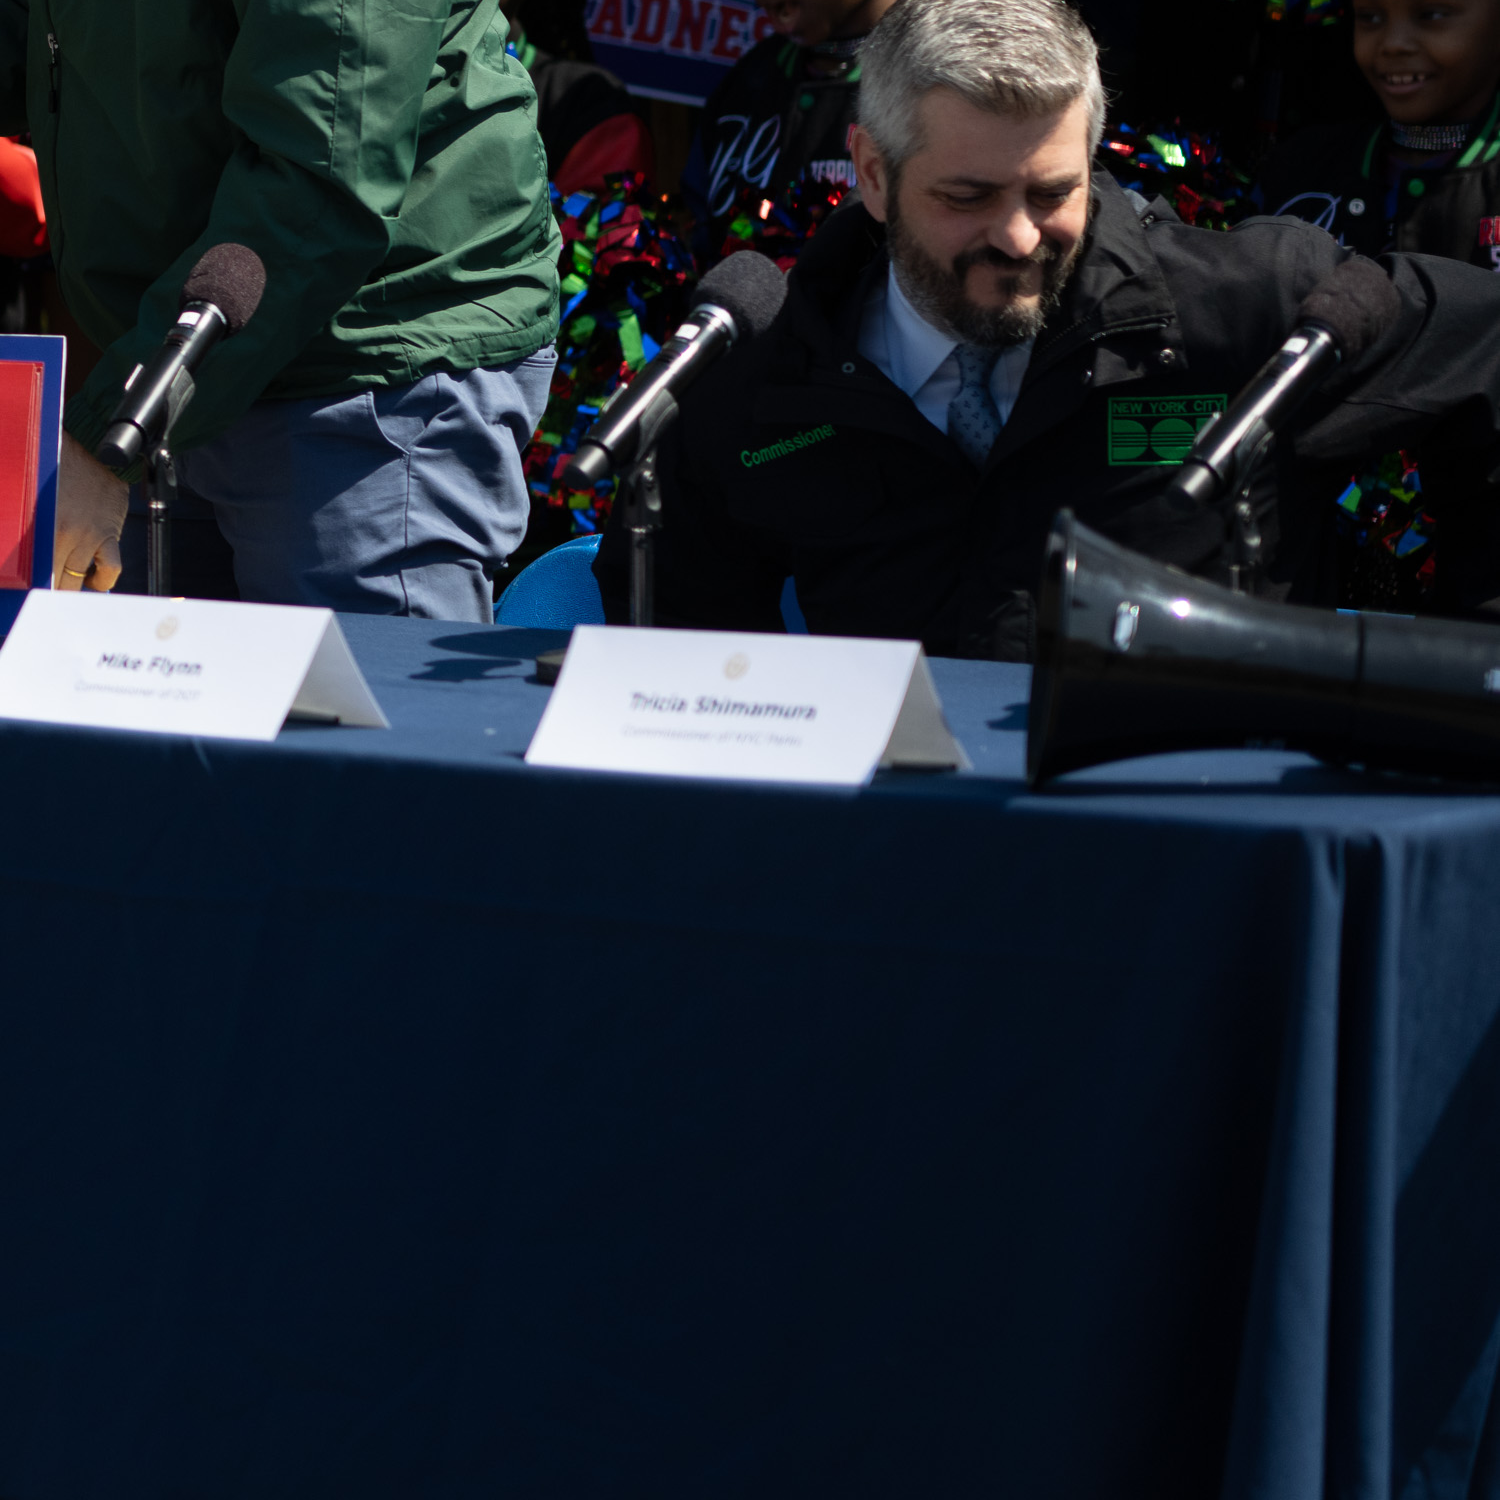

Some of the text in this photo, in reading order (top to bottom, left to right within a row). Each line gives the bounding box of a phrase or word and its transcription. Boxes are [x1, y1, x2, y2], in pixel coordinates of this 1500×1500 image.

[1112, 400, 1223, 414] NEW YORK CITY
[740, 423, 837, 468] Commissioner
[98, 652, 202, 678] Mike Flynn
[631, 691, 817, 720] Tricia Shimamura
